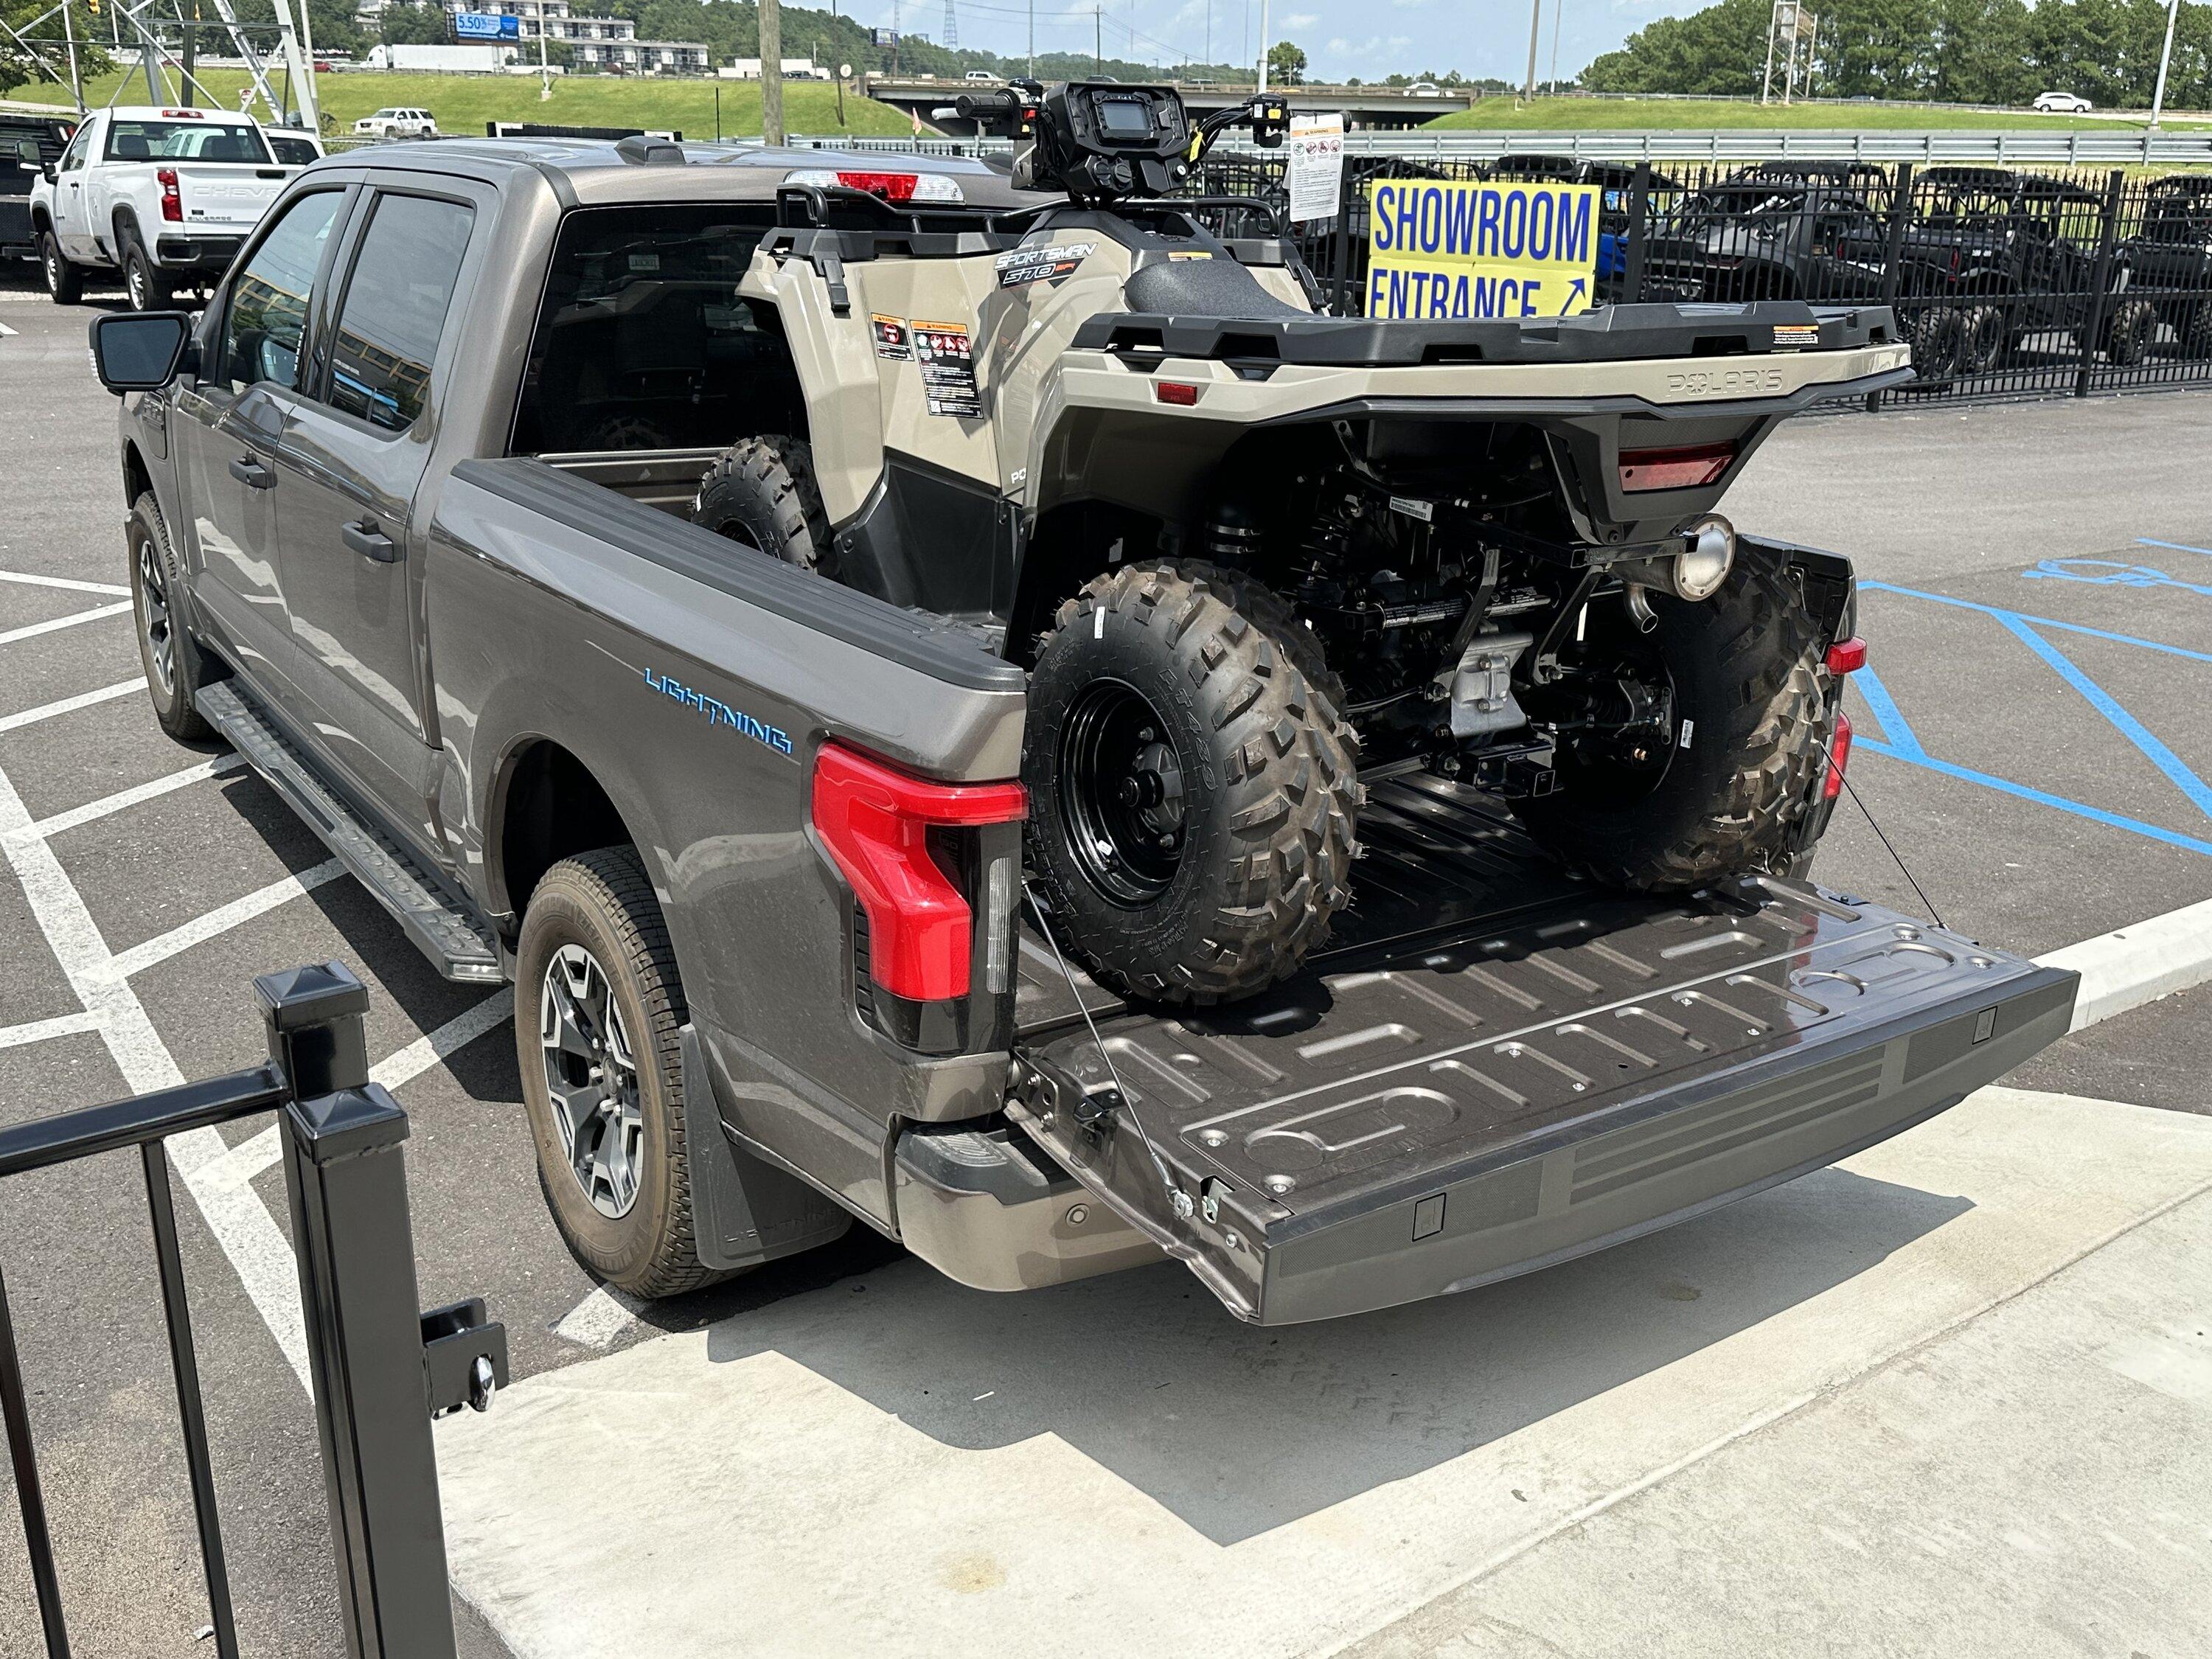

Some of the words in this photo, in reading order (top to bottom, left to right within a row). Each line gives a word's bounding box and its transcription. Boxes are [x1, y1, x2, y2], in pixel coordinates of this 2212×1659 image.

[1375, 186, 1592, 262] SHOWROOM
[994, 242, 1099, 270] SPORTSMAN
[1003, 262, 1057, 285] 570
[1369, 268, 1541, 319] ENTRANCE
[1666, 369, 1783, 397] POLARIS
[644, 667, 792, 754] LIGHTNING
